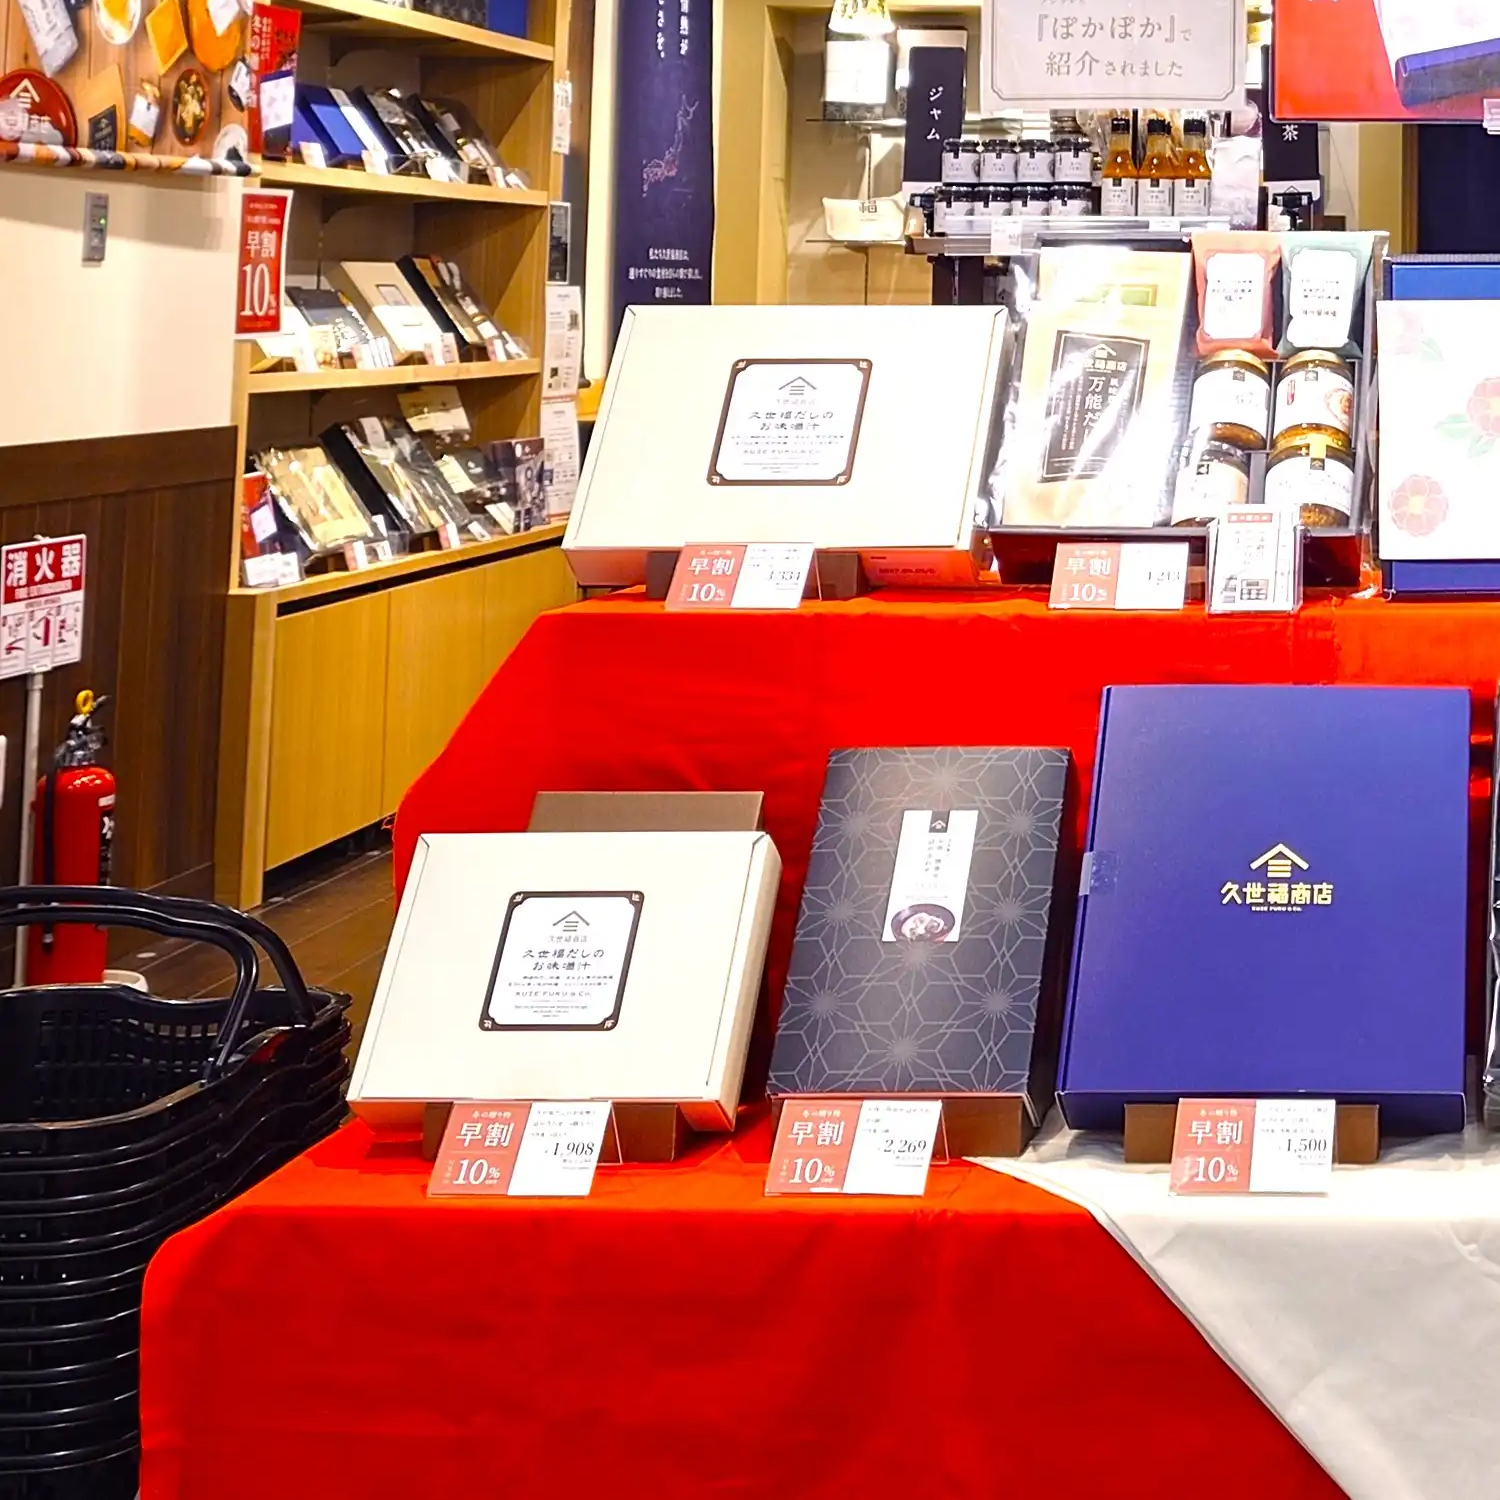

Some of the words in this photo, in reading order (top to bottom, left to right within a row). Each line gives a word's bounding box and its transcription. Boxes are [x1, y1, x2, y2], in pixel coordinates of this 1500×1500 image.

[1045, 50, 1183, 77] 紹介されました
[925, 86, 944, 141] ジャム
[1281, 124, 1299, 141] 茶
[245, 230, 277, 258] 早割
[6, 542, 82, 587] 消火器
[687, 556, 736, 576] 早割
[1063, 557, 1112, 576] 早割
[1220, 882, 1334, 905] 久世福商店
[522, 948, 605, 959] 久世福だしの
[455, 1121, 515, 1148] 早割
[787, 1120, 845, 1146] 早割
[1188, 1119, 1244, 1146] 早割
